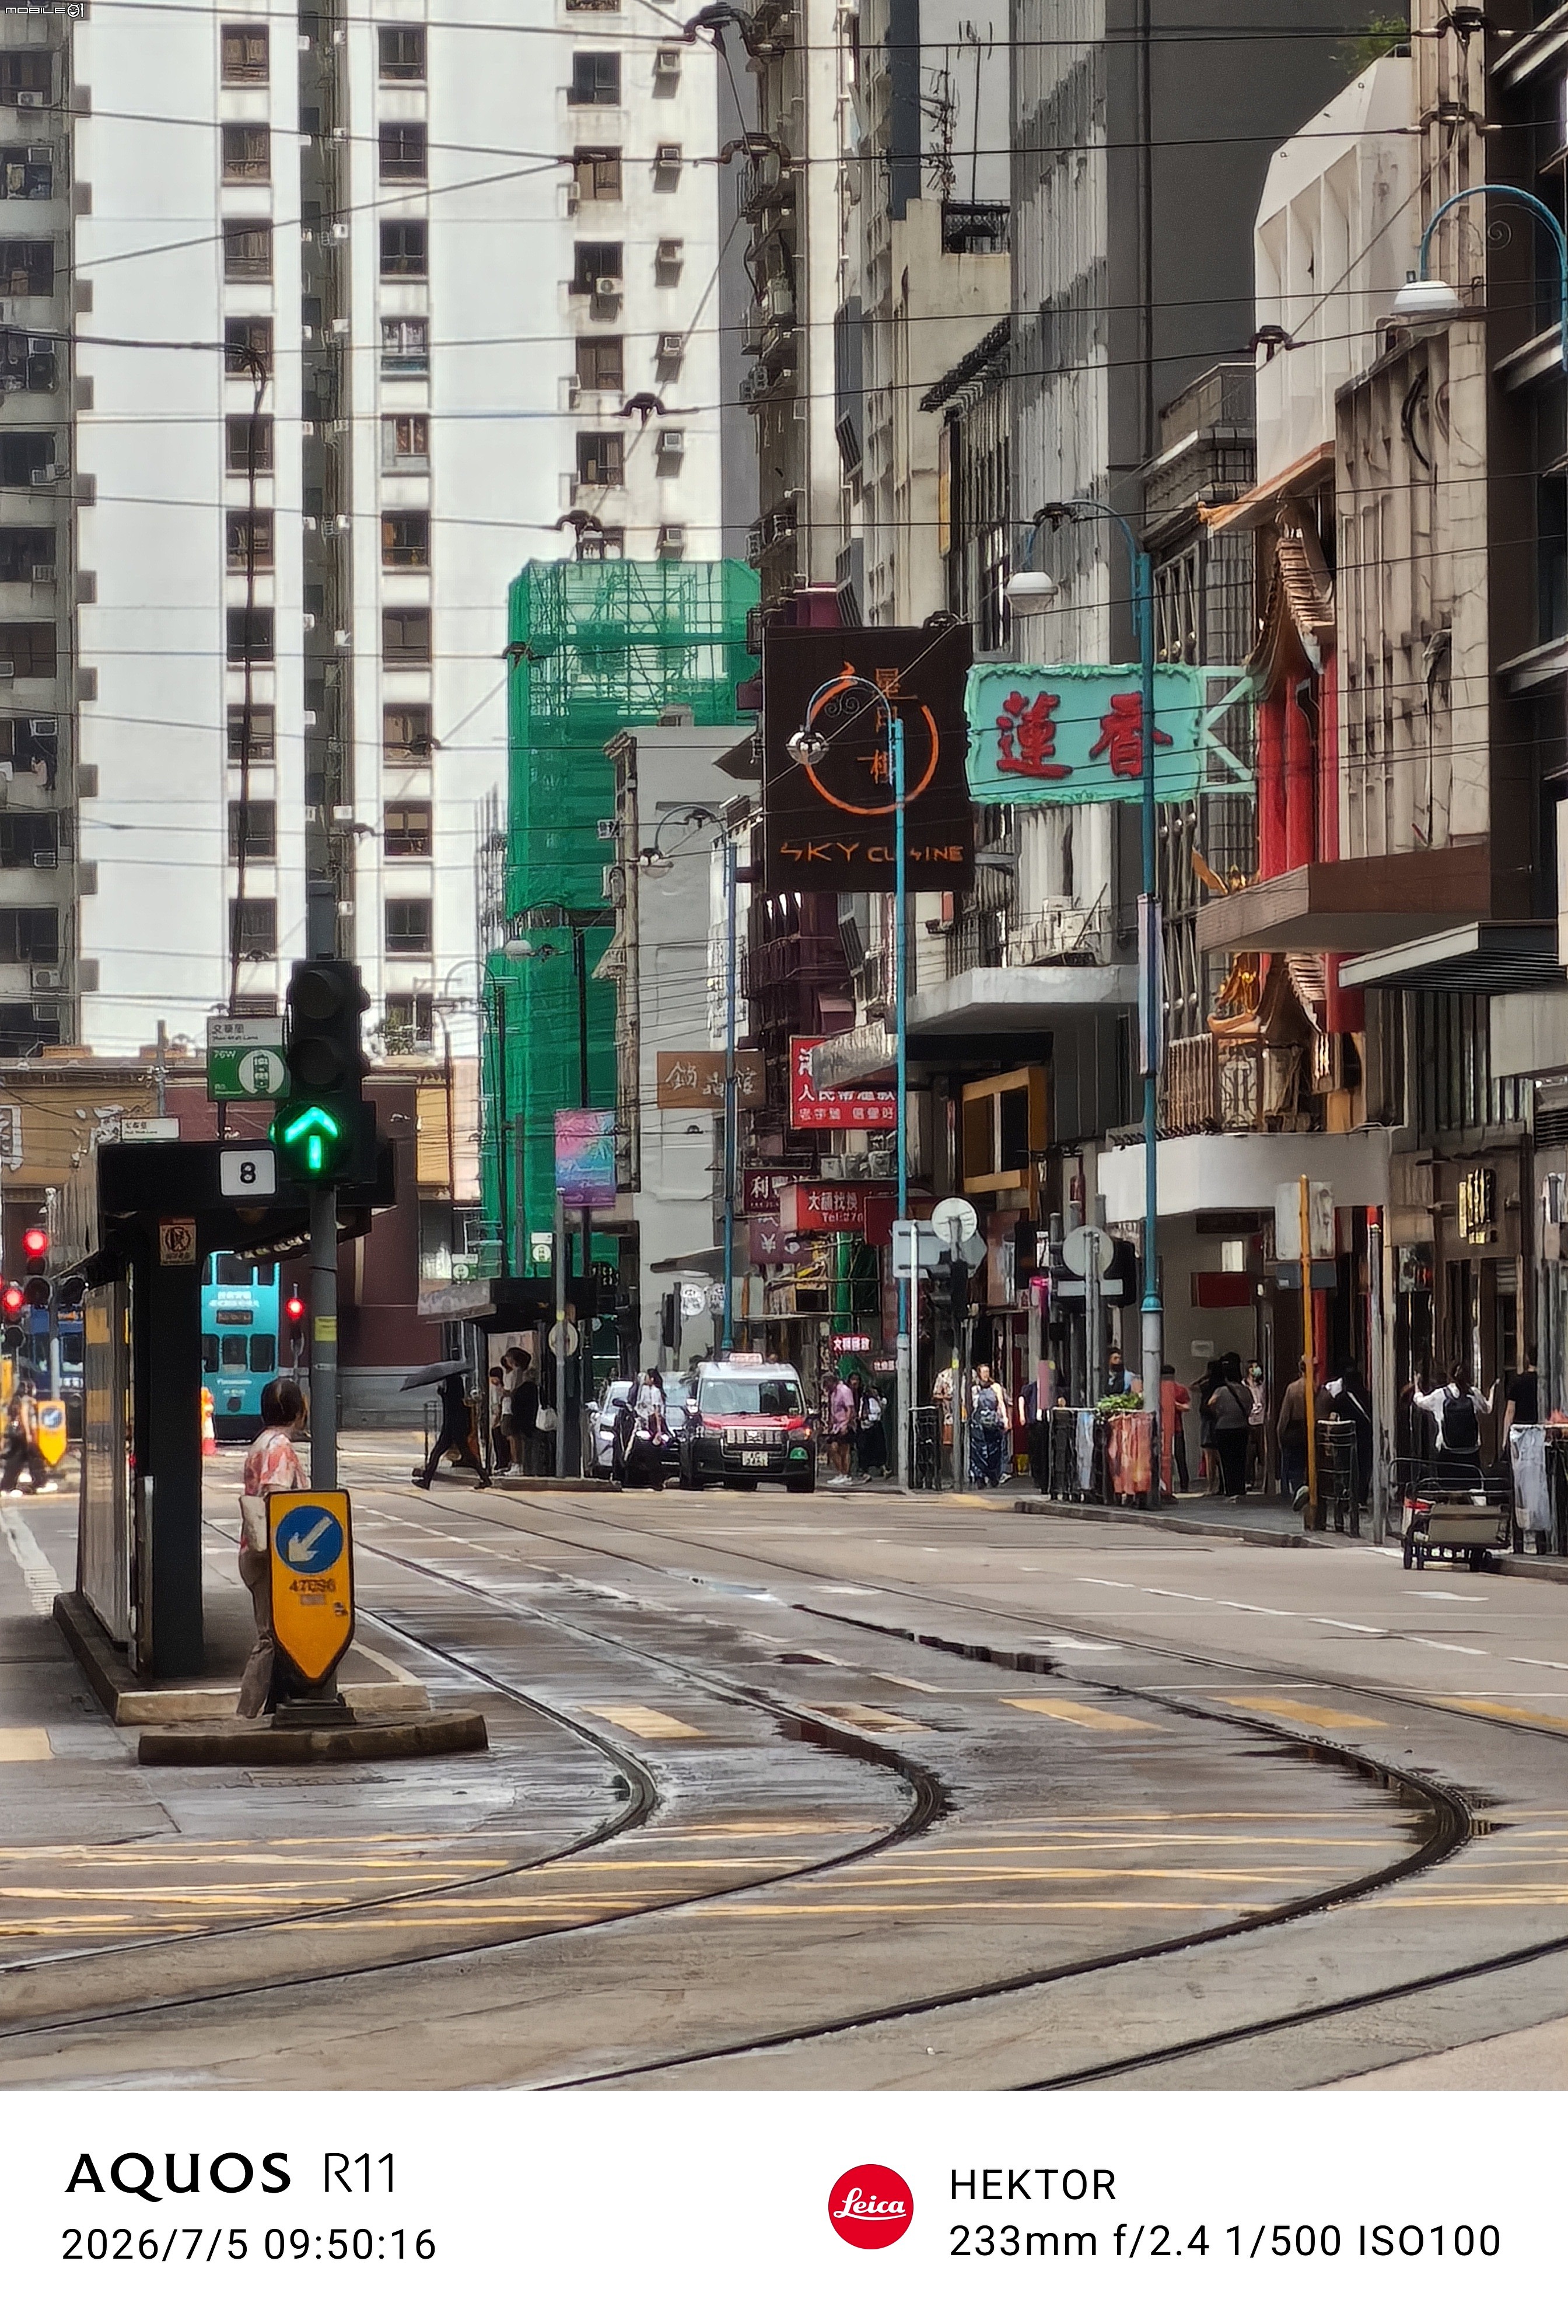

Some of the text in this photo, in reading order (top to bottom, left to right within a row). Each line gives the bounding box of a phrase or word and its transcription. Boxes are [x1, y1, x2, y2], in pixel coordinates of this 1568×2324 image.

[996, 691, 1174, 779] 蓮香
[780, 842, 964, 862] SKY CUSINE
[240, 1162, 256, 1184] 8
